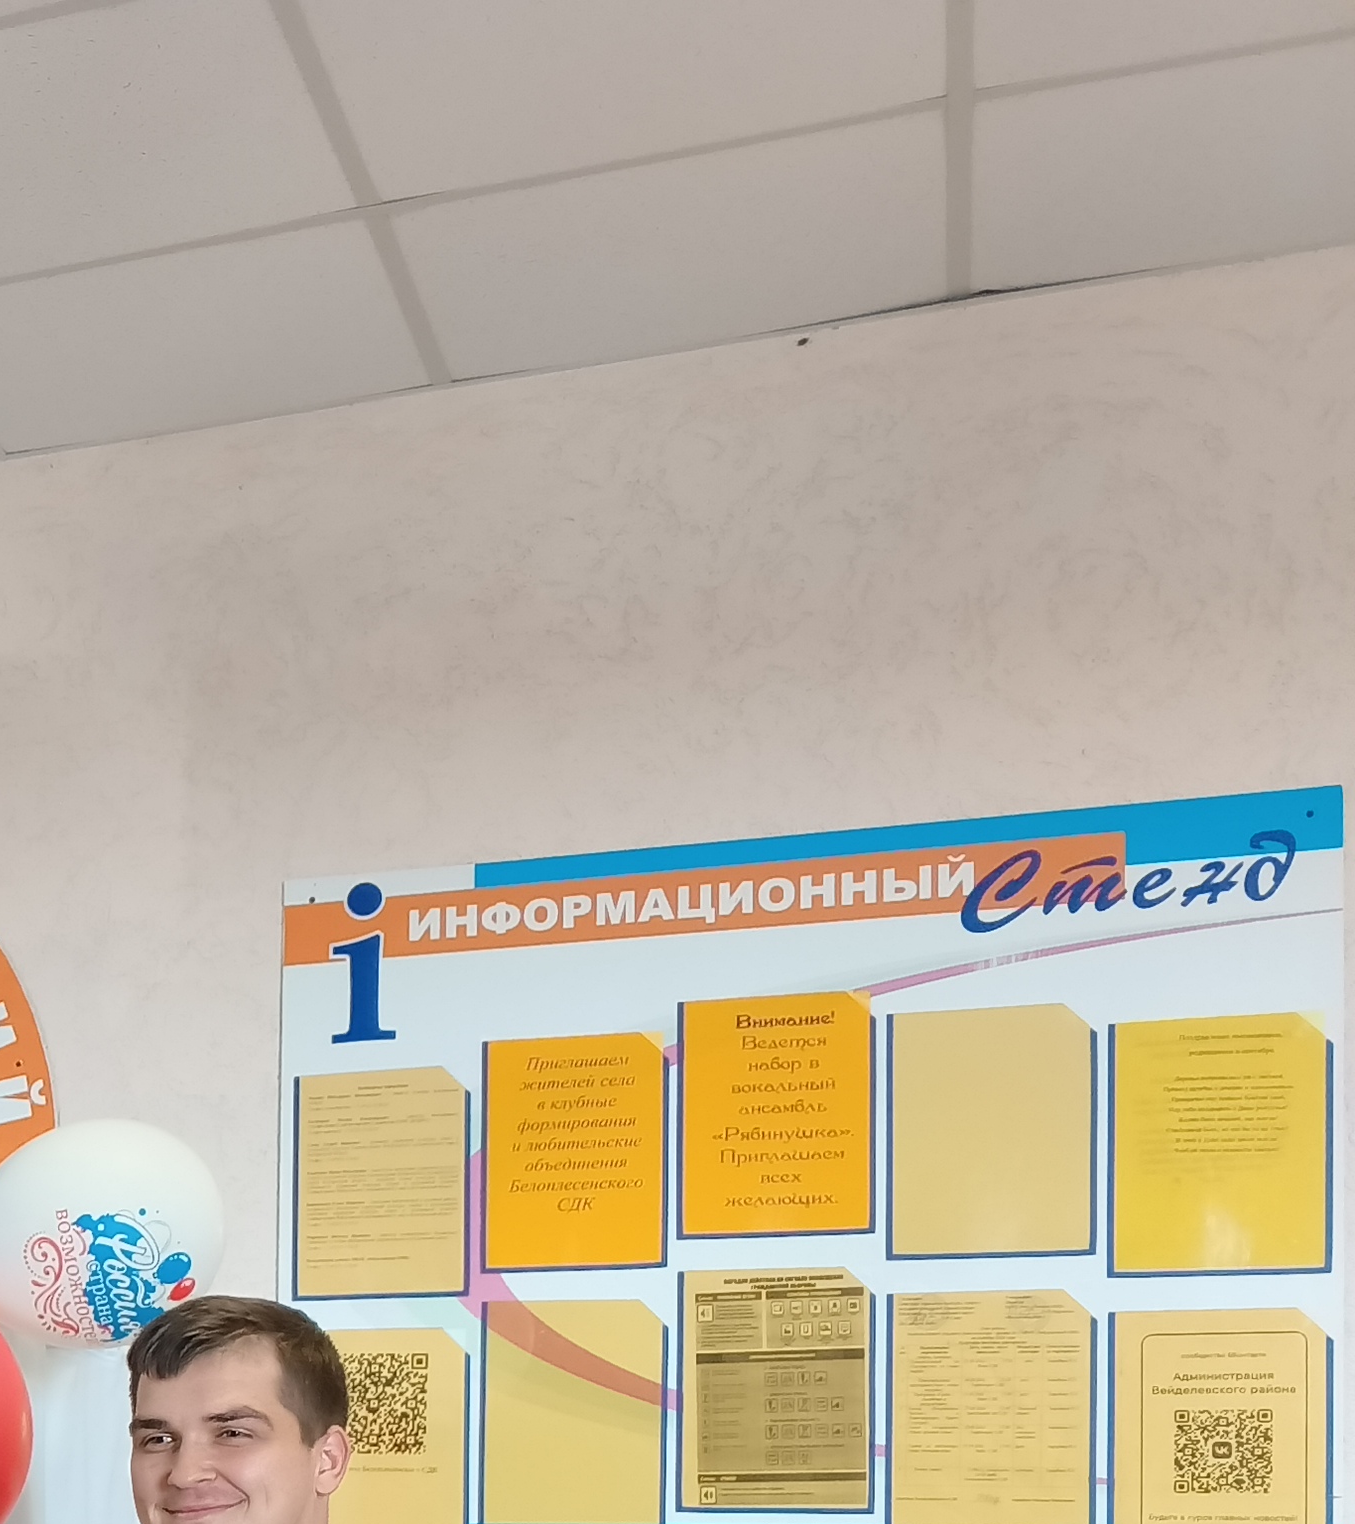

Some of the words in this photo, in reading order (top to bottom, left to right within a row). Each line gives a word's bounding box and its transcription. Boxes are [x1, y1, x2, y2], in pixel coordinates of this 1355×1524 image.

[408, 855, 975, 944] ИНФОРМАЦИОННЫЙ
[960, 829, 1298, 936] Стенд
[736, 1010, 835, 1029] Внимание!
[741, 1035, 827, 1051] Ведется
[526, 1056, 629, 1073] Приглашаем
[748, 1056, 802, 1074] набор
[809, 1059, 820, 1069] в
[519, 1074, 594, 1091] жителей
[600, 1075, 636, 1087] села
[731, 1077, 836, 1095] вокальный
[537, 1101, 545, 1110] в
[550, 1095, 618, 1112] клубные
[738, 1099, 828, 1115] ансамбль
[517, 1116, 637, 1135] формирования
[712, 1126, 854, 1144] «Рябинушка».
[511, 1143, 520, 1153] и
[525, 1137, 642, 1152] любительские
[524, 1158, 628, 1172] объединения
[720, 1148, 845, 1168] Приглашаем
[509, 1178, 644, 1193] Белоплесенского
[760, 1173, 802, 1184] всех
[557, 1197, 596, 1214] СДК
[724, 1193, 838, 1208] желающих.
[86, 1260, 114, 1325] страна
[1173, 1372, 1275, 1382] Администрация
[1152, 1384, 1246, 1395] Вейделевского
[1250, 1384, 1296, 1395] района
